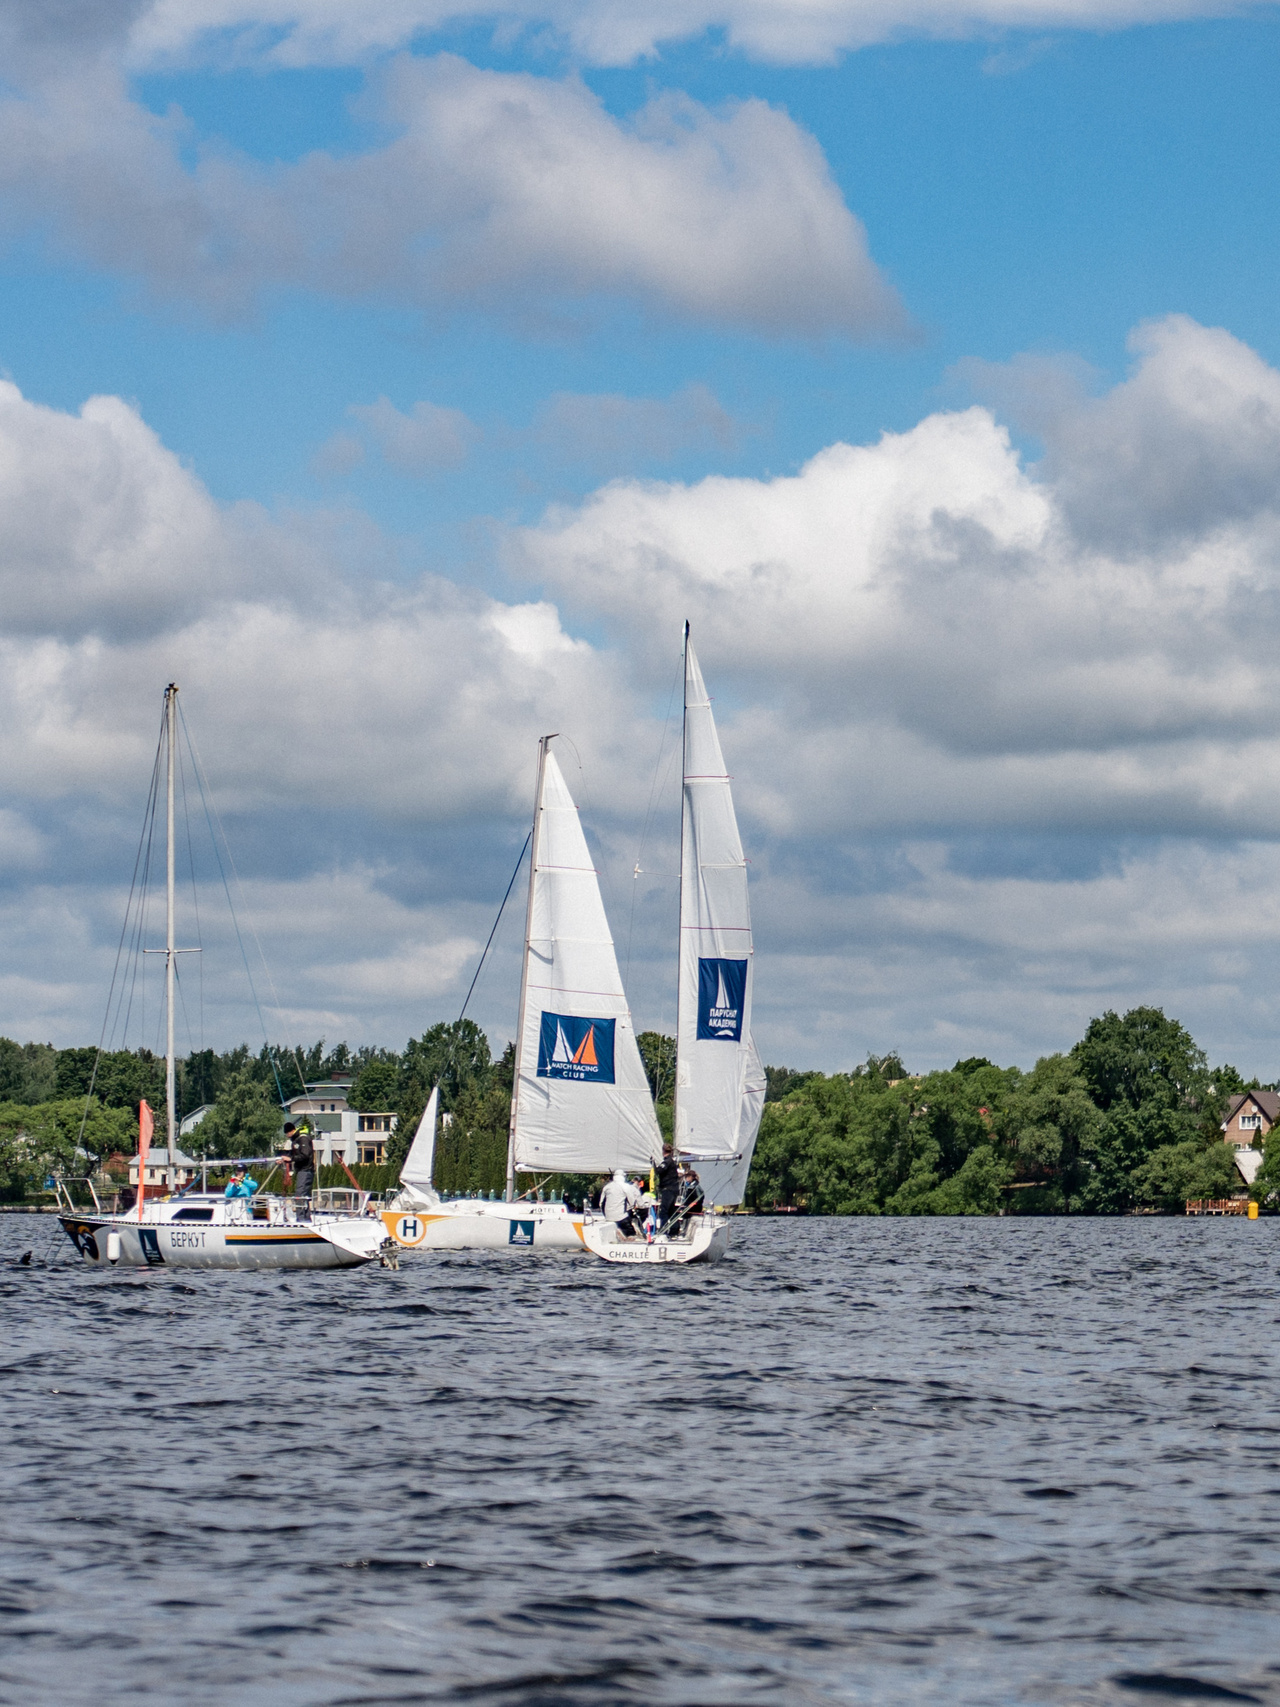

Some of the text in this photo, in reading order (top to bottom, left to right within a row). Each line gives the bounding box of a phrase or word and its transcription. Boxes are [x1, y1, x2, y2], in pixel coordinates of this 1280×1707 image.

[552, 1062, 598, 1073] MATCH RACING
[562, 1071, 585, 1079] CLUB
[171, 1231, 205, 1248] БЕРКУТ
[609, 1250, 650, 1259] CHARLIE
